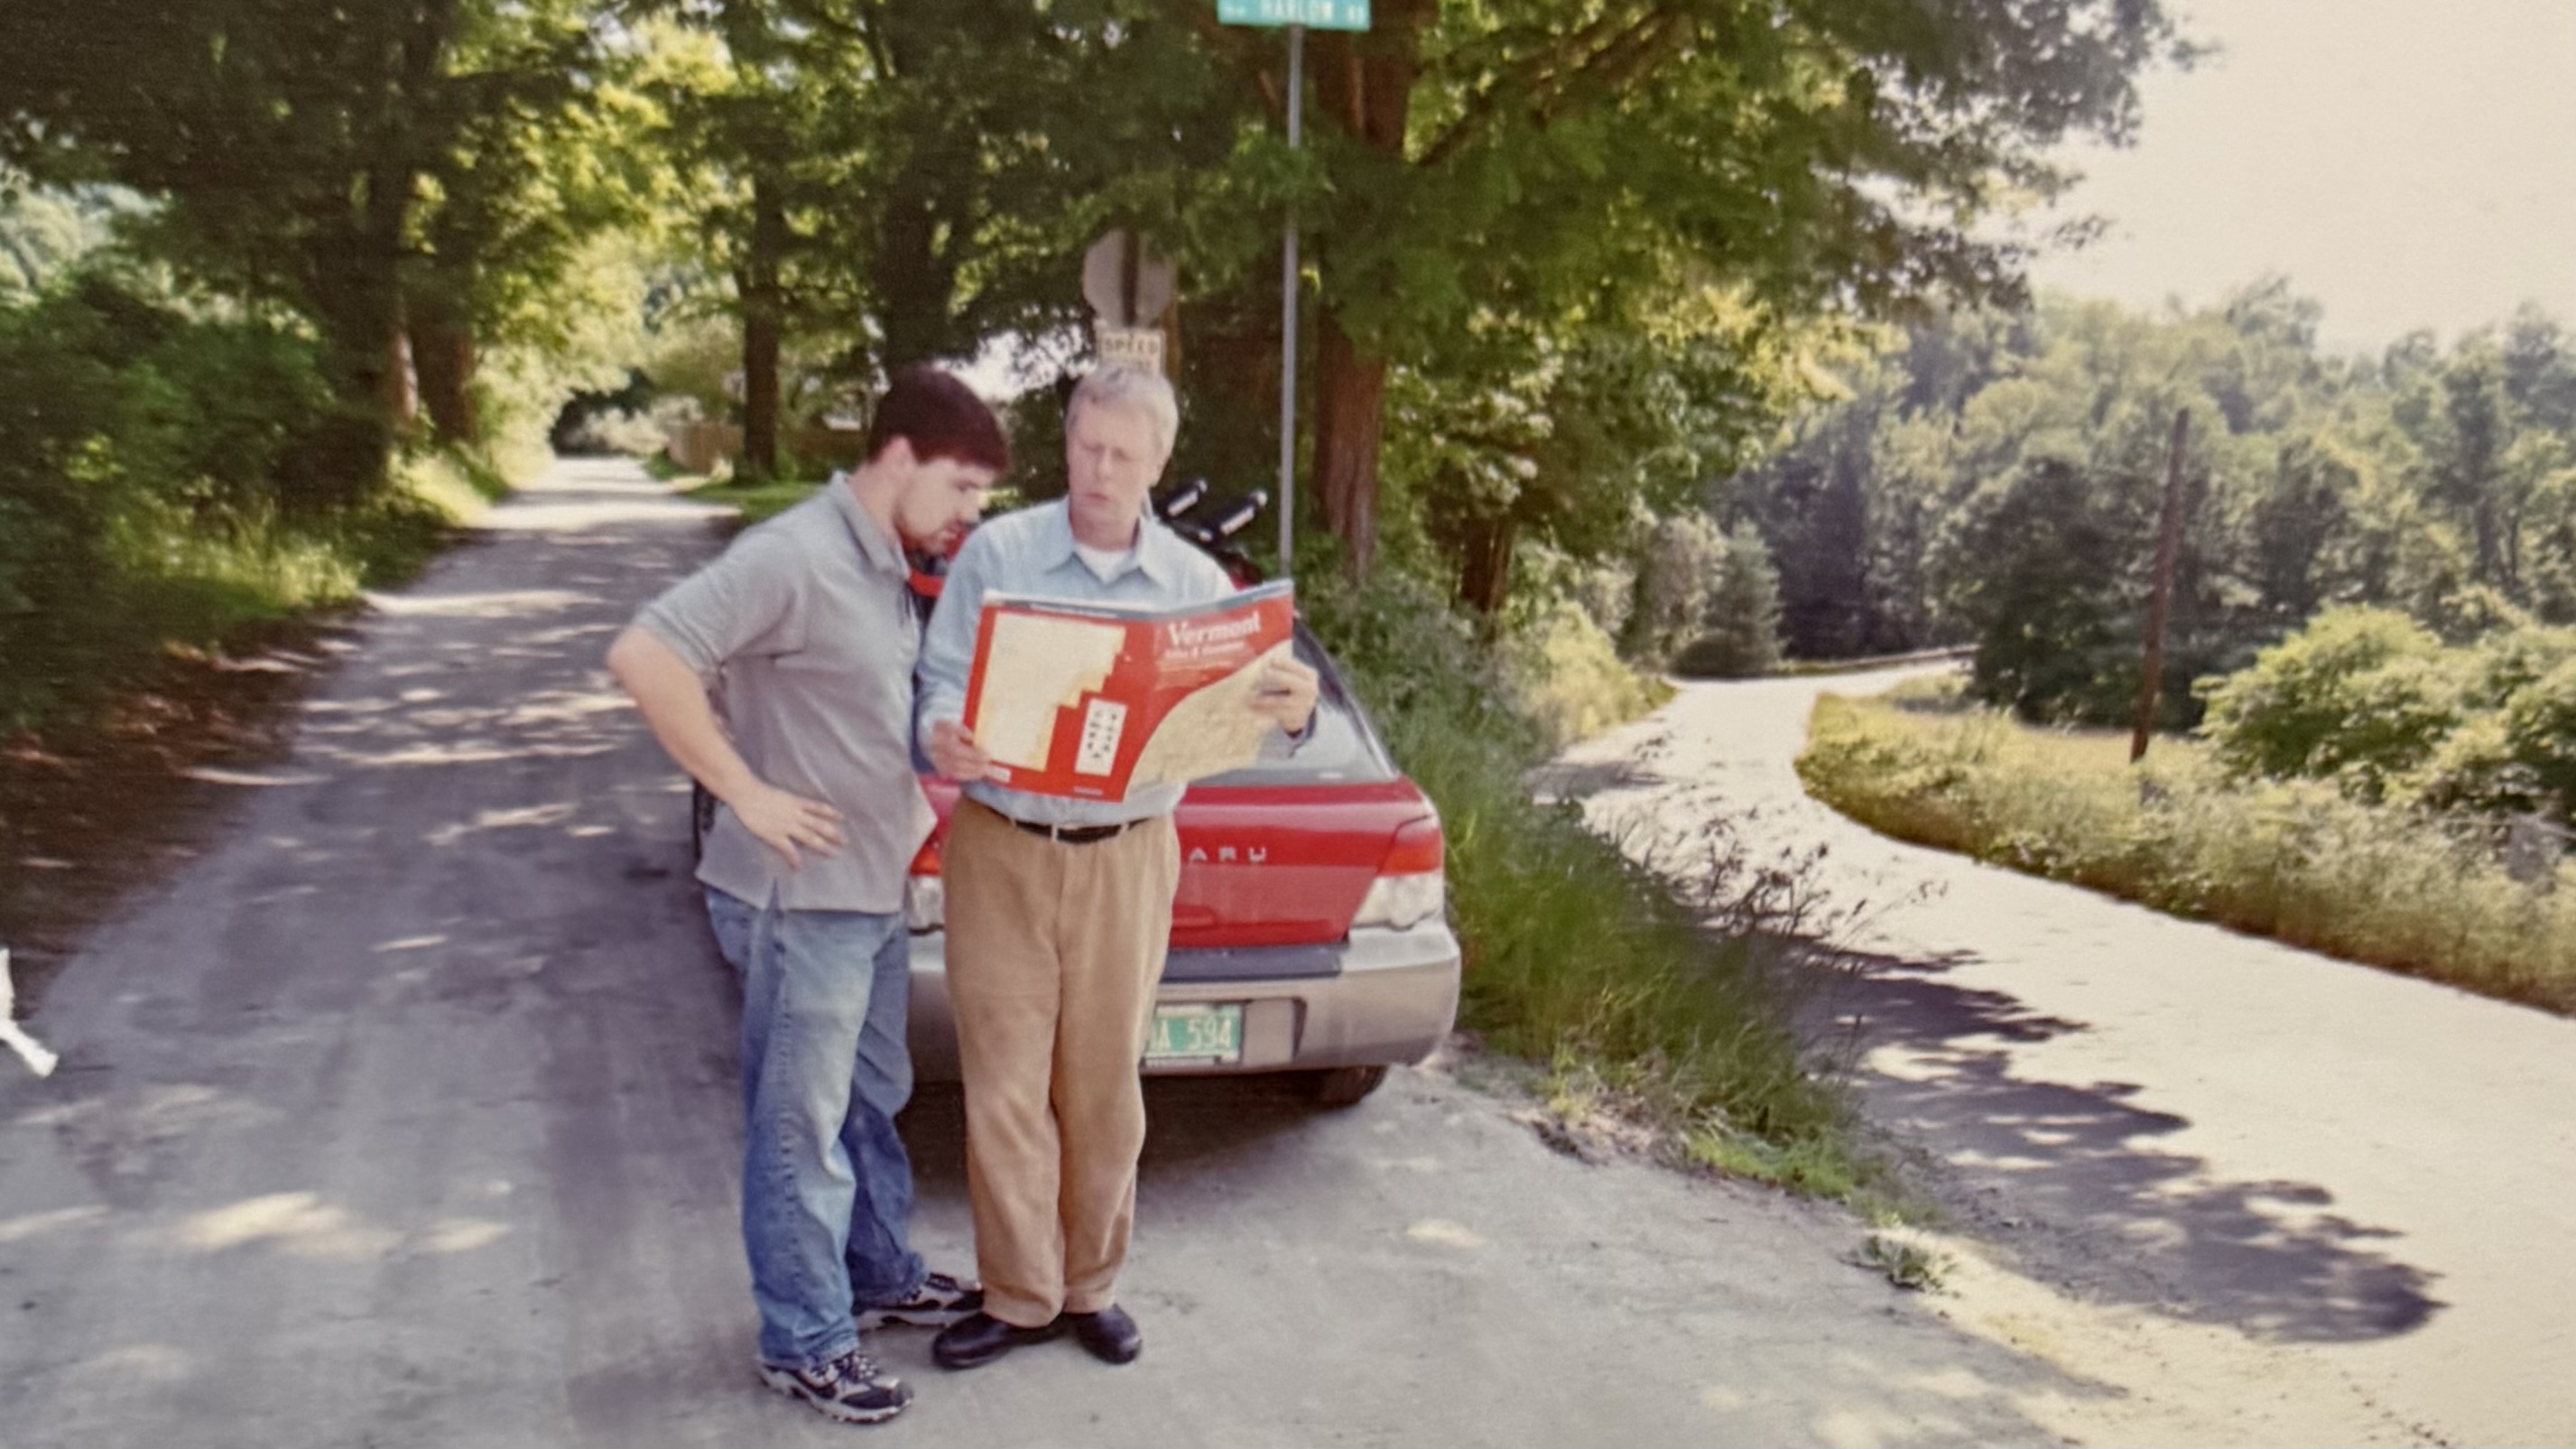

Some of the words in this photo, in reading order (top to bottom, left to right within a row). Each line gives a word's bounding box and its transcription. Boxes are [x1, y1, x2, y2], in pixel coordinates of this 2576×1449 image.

[1105, 337, 1160, 355] SPEED
[1168, 610, 1261, 646] Vermont
[1189, 846, 1266, 862] ARU
[1187, 1017, 1232, 1050] 594
